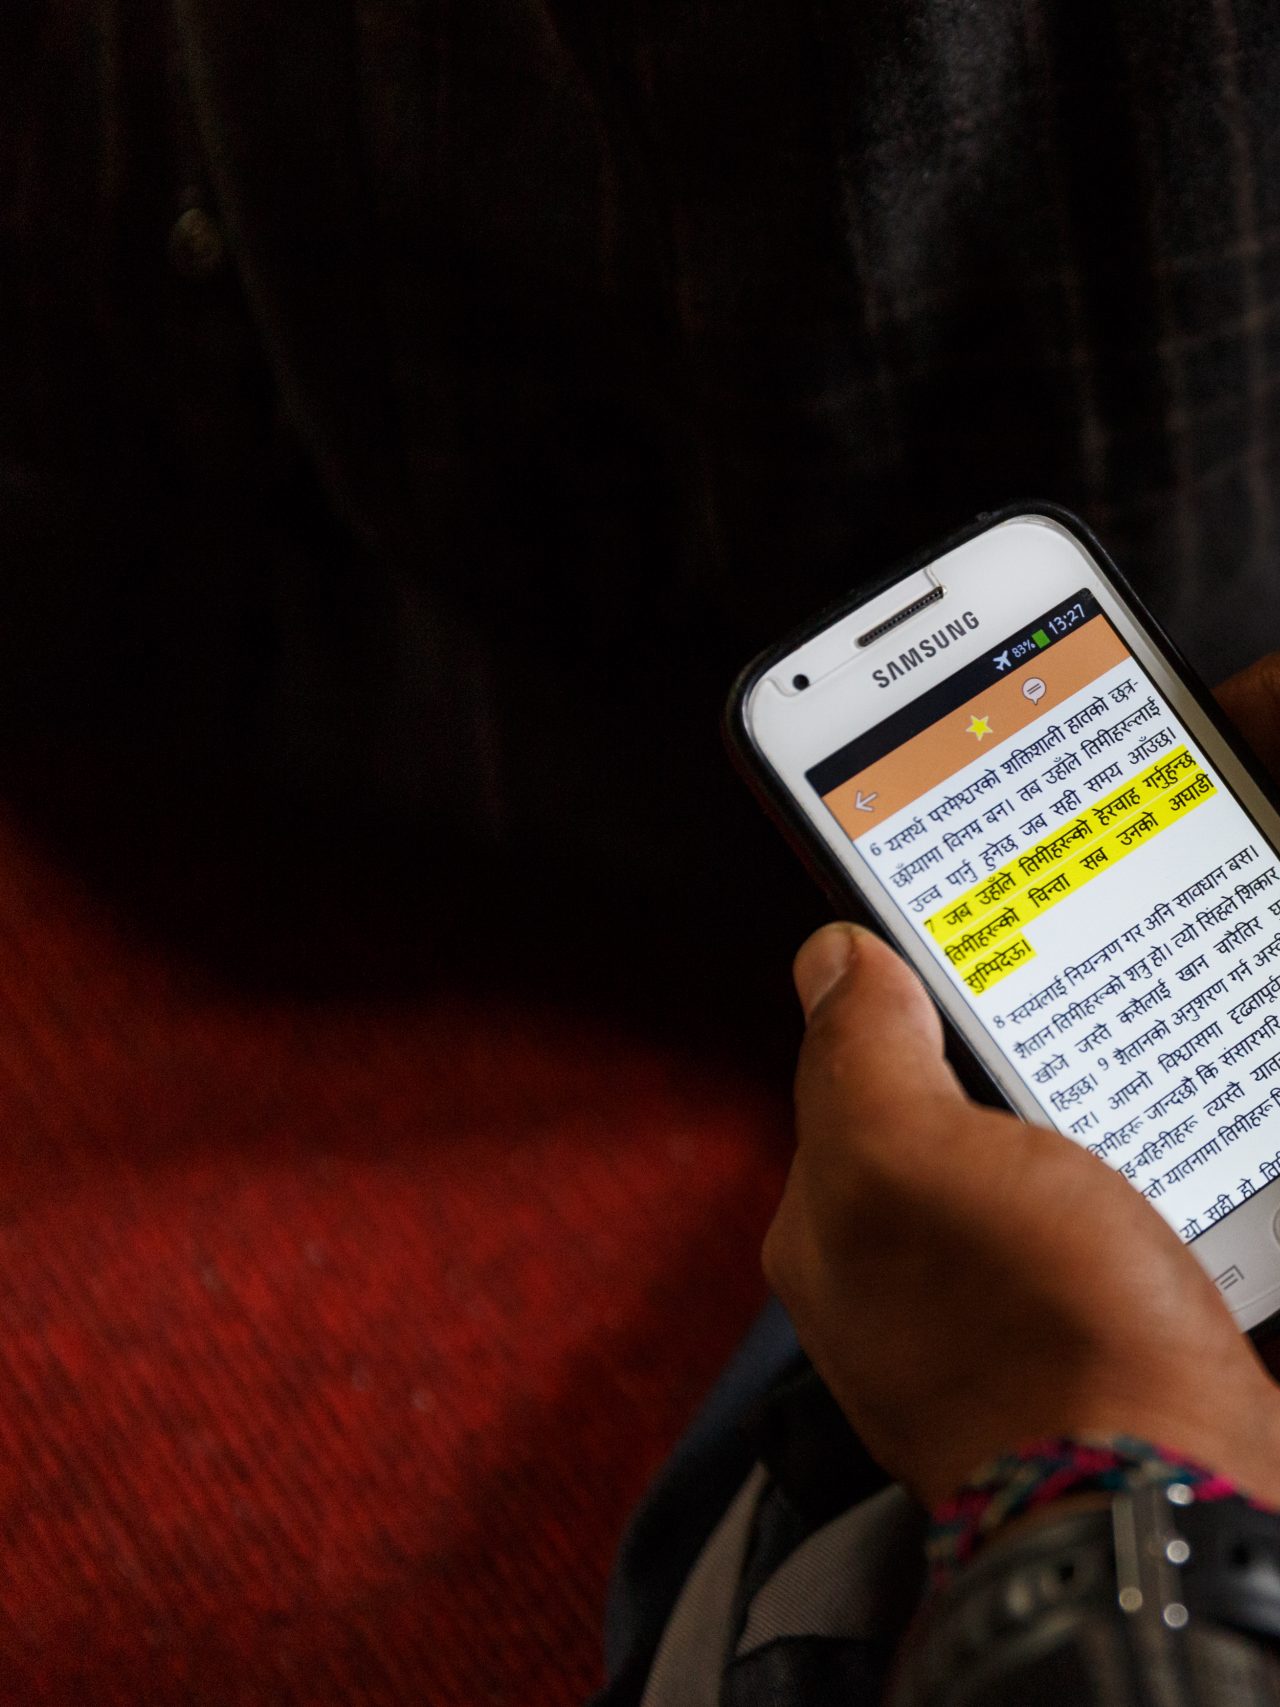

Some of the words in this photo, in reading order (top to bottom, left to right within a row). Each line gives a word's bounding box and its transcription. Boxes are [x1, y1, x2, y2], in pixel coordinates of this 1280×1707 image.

[872, 611, 980, 689] SAMSUNG
[1011, 639, 1036, 659] 83%
[1048, 603, 1086, 635] 13:27
[869, 842, 882, 857] 6
[884, 816, 928, 852] यसर्थ
[926, 768, 1002, 823] परमेश्वरको
[999, 724, 1067, 775] शक्तिशाली
[1062, 695, 1110, 735] हातको
[1107, 678, 1139, 704] छत्र-
[907, 884, 943, 913] उच्च
[944, 858, 979, 886] पार्नु
[977, 833, 1019, 872] हुनेछ
[1018, 811, 1049, 836] जब
[1048, 789, 1083, 816] सही
[1082, 761, 1124, 793] समय
[1127, 726, 1177, 765] आउँछ।
[941, 818, 984, 853] विनम्र
[981, 798, 1016, 824] बन।
[1015, 778, 1044, 802] तब
[1040, 751, 1083, 785] उहाँले
[1079, 695, 1162, 760] तिमीहरूलाई
[923, 918, 934, 932] 7
[942, 901, 973, 926] जब
[974, 871, 1017, 905] उहाँले
[1017, 818, 1094, 877] तिमीहरूको
[1090, 786, 1141, 827] हेरचाह
[1141, 749, 1197, 790] गर्नुहुन्छ
[943, 906, 1021, 966] तिमीहरूको
[1027, 872, 1071, 909] चिन्ता
[1078, 846, 1109, 871] सब
[1115, 810, 1159, 846] उनको
[1167, 772, 1215, 812] अघाडी
[963, 938, 1032, 993] सुम्पिदेऊ।
[992, 1015, 1006, 1029] 8
[1006, 974, 1069, 1025] स्वयंलाई
[1063, 937, 1125, 987] नियन्त्रण
[1120, 923, 1146, 944] गर
[1143, 901, 1176, 931] अनि
[1171, 864, 1229, 909] सावधान
[1224, 844, 1260, 872] बस।
[1013, 1024, 1056, 1059] शैतान
[1051, 974, 1127, 1034] तिमीहरूको
[1122, 956, 1153, 982] शत्रु
[1146, 942, 1174, 968] हो।
[1169, 922, 1200, 949] त्यो
[1195, 895, 1239, 932] सिंहले
[1233, 865, 1280, 905] शिकार
[1032, 1053, 1070, 1084] खोजे
[1074, 1022, 1113, 1054] जस्तै
[1115, 977, 1173, 1024] कसैलाई
[1174, 953, 1210, 982] खान
[1212, 915, 1264, 954] चारैतिर
[1068, 1111, 1100, 1134] गर।
[1107, 1070, 1154, 1110] आफ्नो
[1157, 1020, 1224, 1074] विश्वासमा
[1097, 1057, 1110, 1071] 9
[1112, 1019, 1172, 1066] शैतानको
[1170, 977, 1230, 1026] अनुशरण
[1226, 958, 1254, 983] गर्न
[1194, 1061, 1219, 1086] कि
[1161, 1137, 1223, 1185] यातनामा
[1216, 1098, 1274, 1147] तिमीहरू
[1202, 1080, 1246, 1117] त्यस्तै
